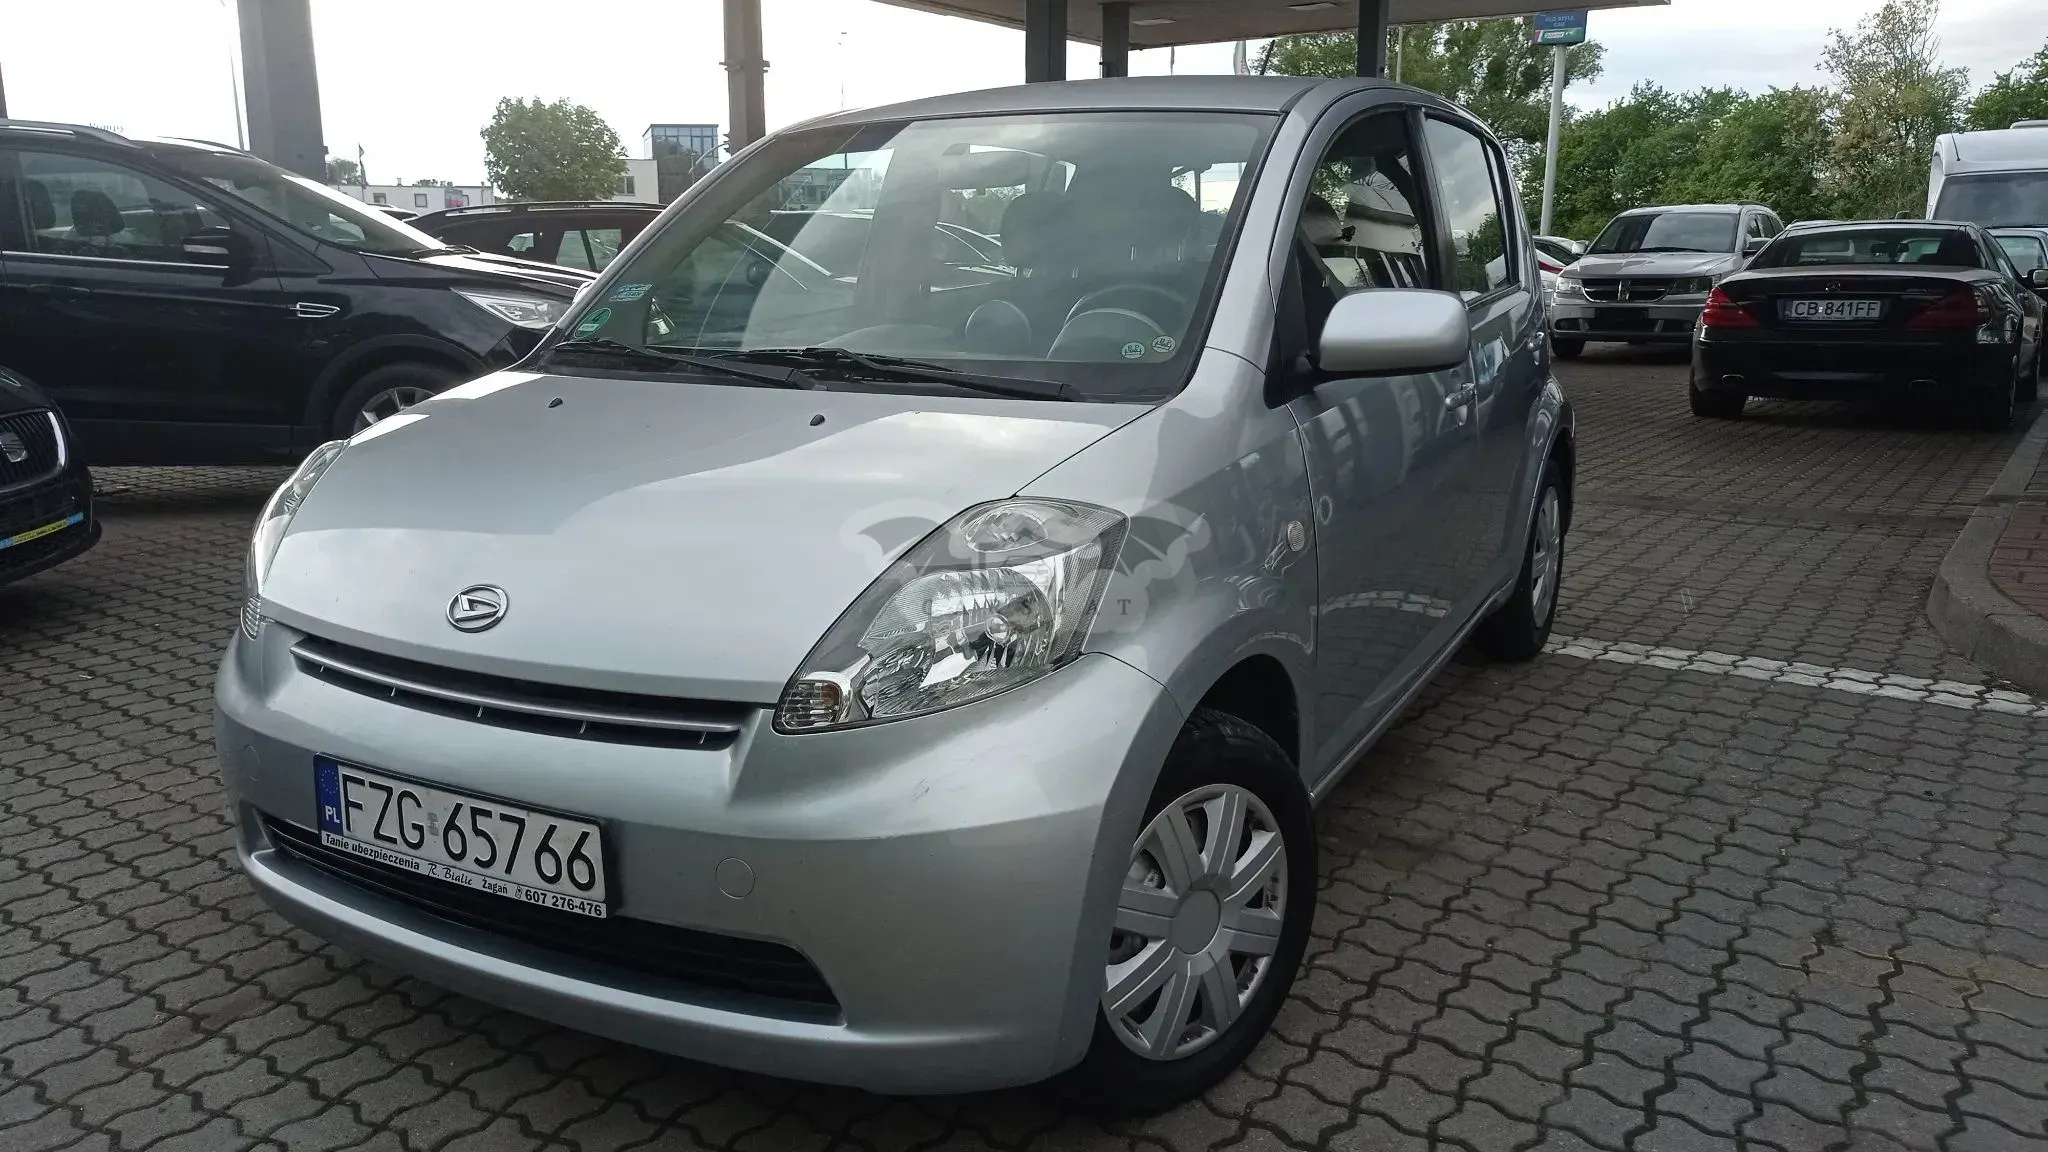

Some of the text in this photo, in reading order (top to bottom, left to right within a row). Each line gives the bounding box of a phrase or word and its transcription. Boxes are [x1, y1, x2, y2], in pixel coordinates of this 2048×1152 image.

[1794, 301, 1878, 316] CB 841FF
[324, 805, 341, 824] PL
[341, 773, 596, 892] FZG 65766
[325, 833, 349, 850] Tanie
[351, 842, 420, 871] ubezpieczenia
[427, 862, 440, 877] R.
[482, 876, 508, 894] Żagań
[525, 889, 547, 905] 607
[551, 894, 602, 917] 276-476
